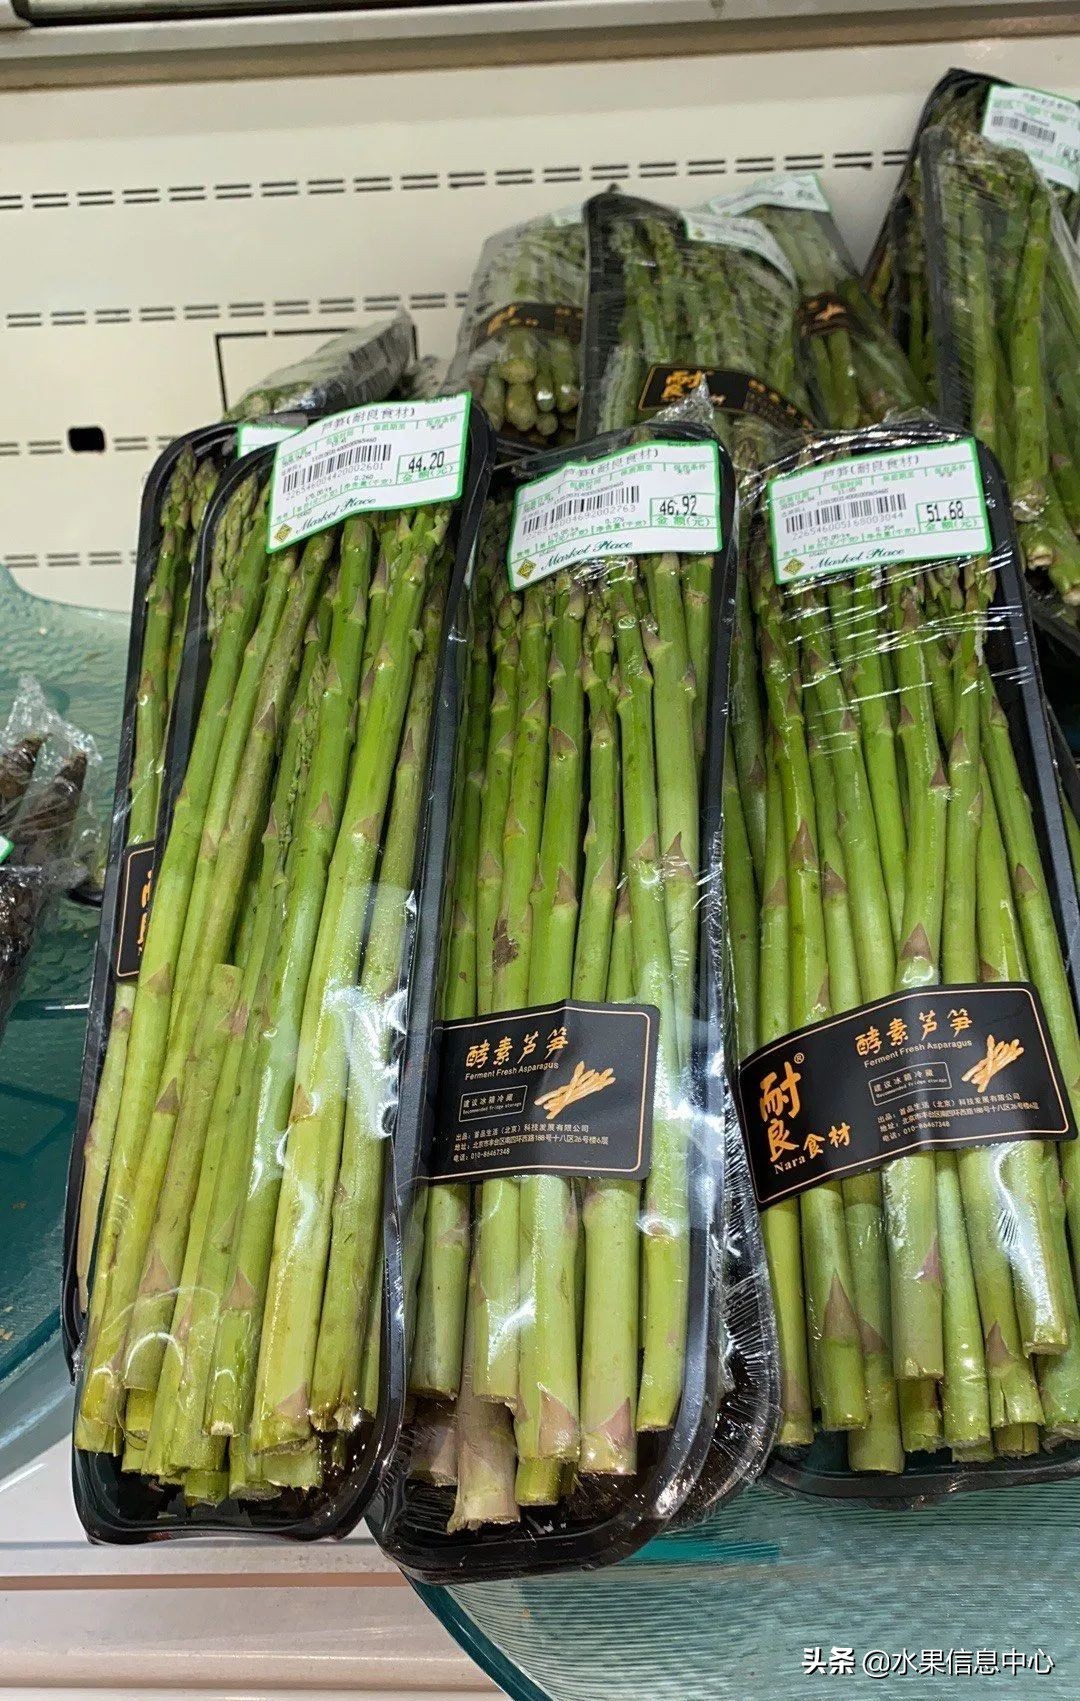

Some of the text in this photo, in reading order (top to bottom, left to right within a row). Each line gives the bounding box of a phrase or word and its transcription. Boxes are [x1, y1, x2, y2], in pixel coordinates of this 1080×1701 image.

[407, 450, 445, 473] 44.20
[658, 494, 698, 516] 46.92
[926, 501, 965, 522] 51.68
[540, 546, 590, 571] Market
[590, 539, 634, 552] Place
[854, 1008, 973, 1057] 酵素芦笋
[464, 1026, 569, 1069] 酵素芦笋
[863, 1038, 973, 1069] Ferment Fresh Asparagus
[464, 1061, 559, 1081] Ferment Fresh Asparagus
[802, 1121, 852, 1159] 食材
[773, 1154, 806, 1176] Nara
